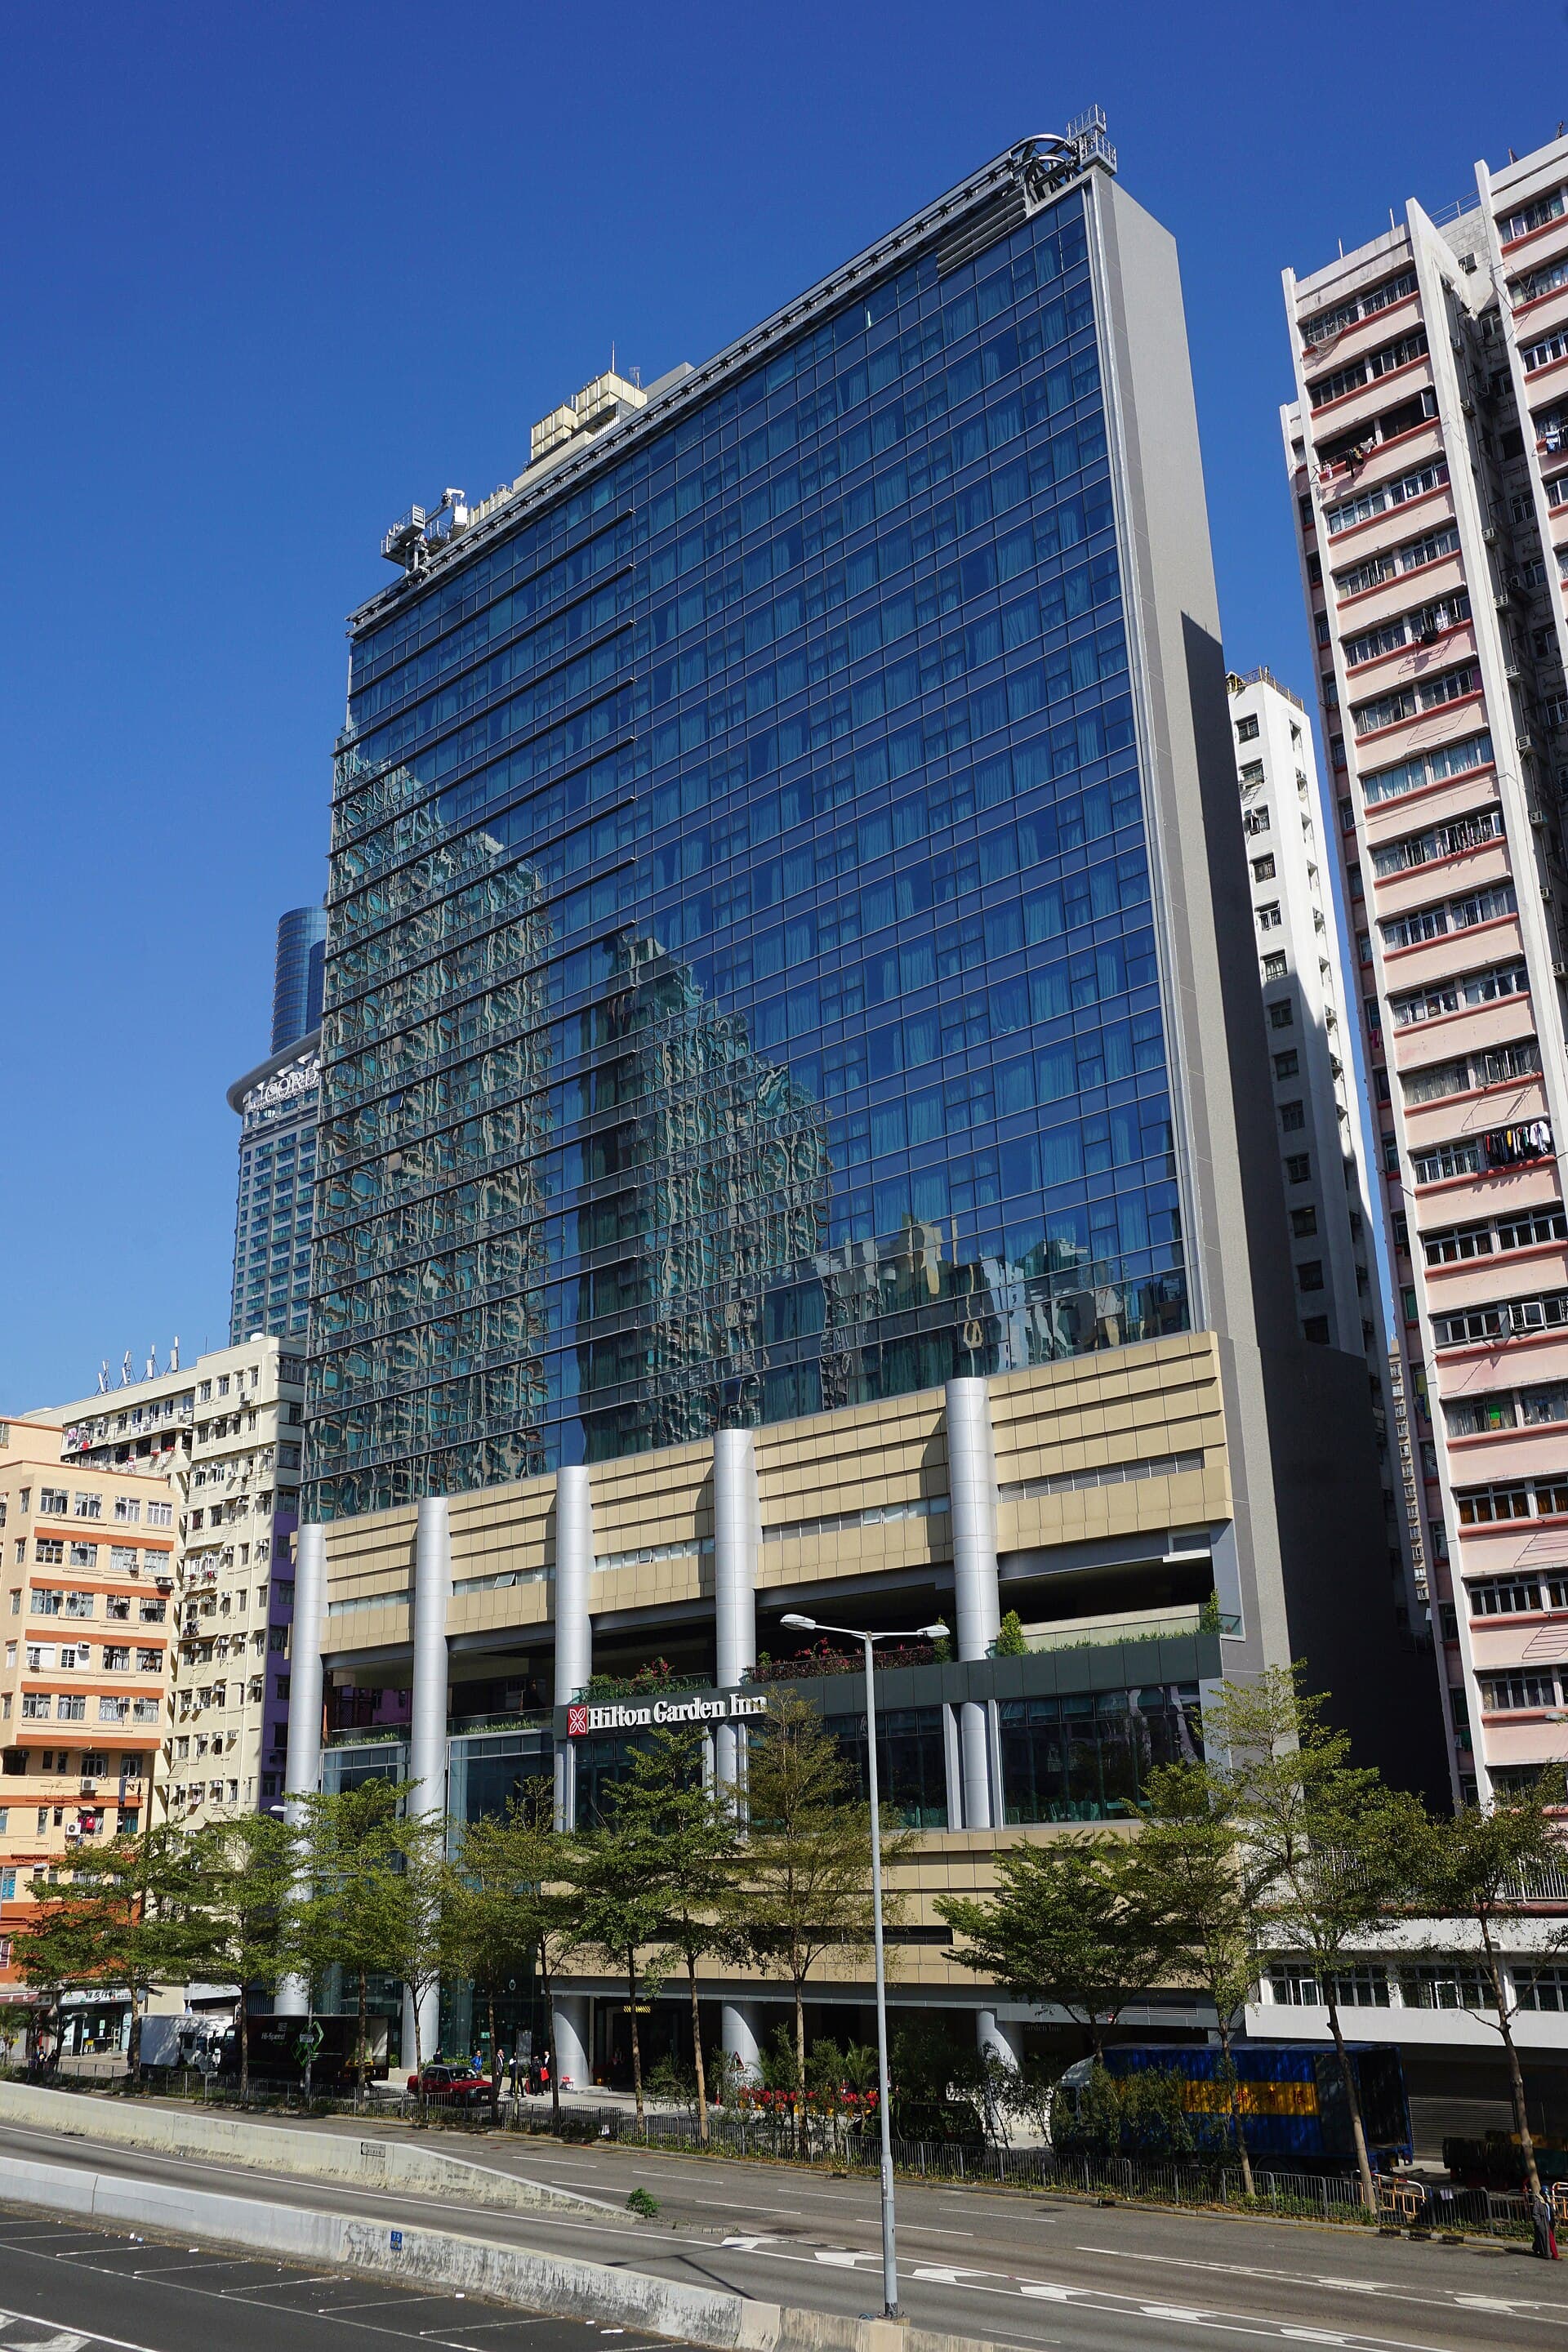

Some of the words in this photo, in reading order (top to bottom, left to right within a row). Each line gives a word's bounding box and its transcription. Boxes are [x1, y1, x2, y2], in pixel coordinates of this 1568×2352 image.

[265, 1067, 318, 1103] CORD
[588, 1704, 653, 1730] Hilton
[653, 1696, 727, 1724] Garden
[728, 1693, 768, 1717] Inn
